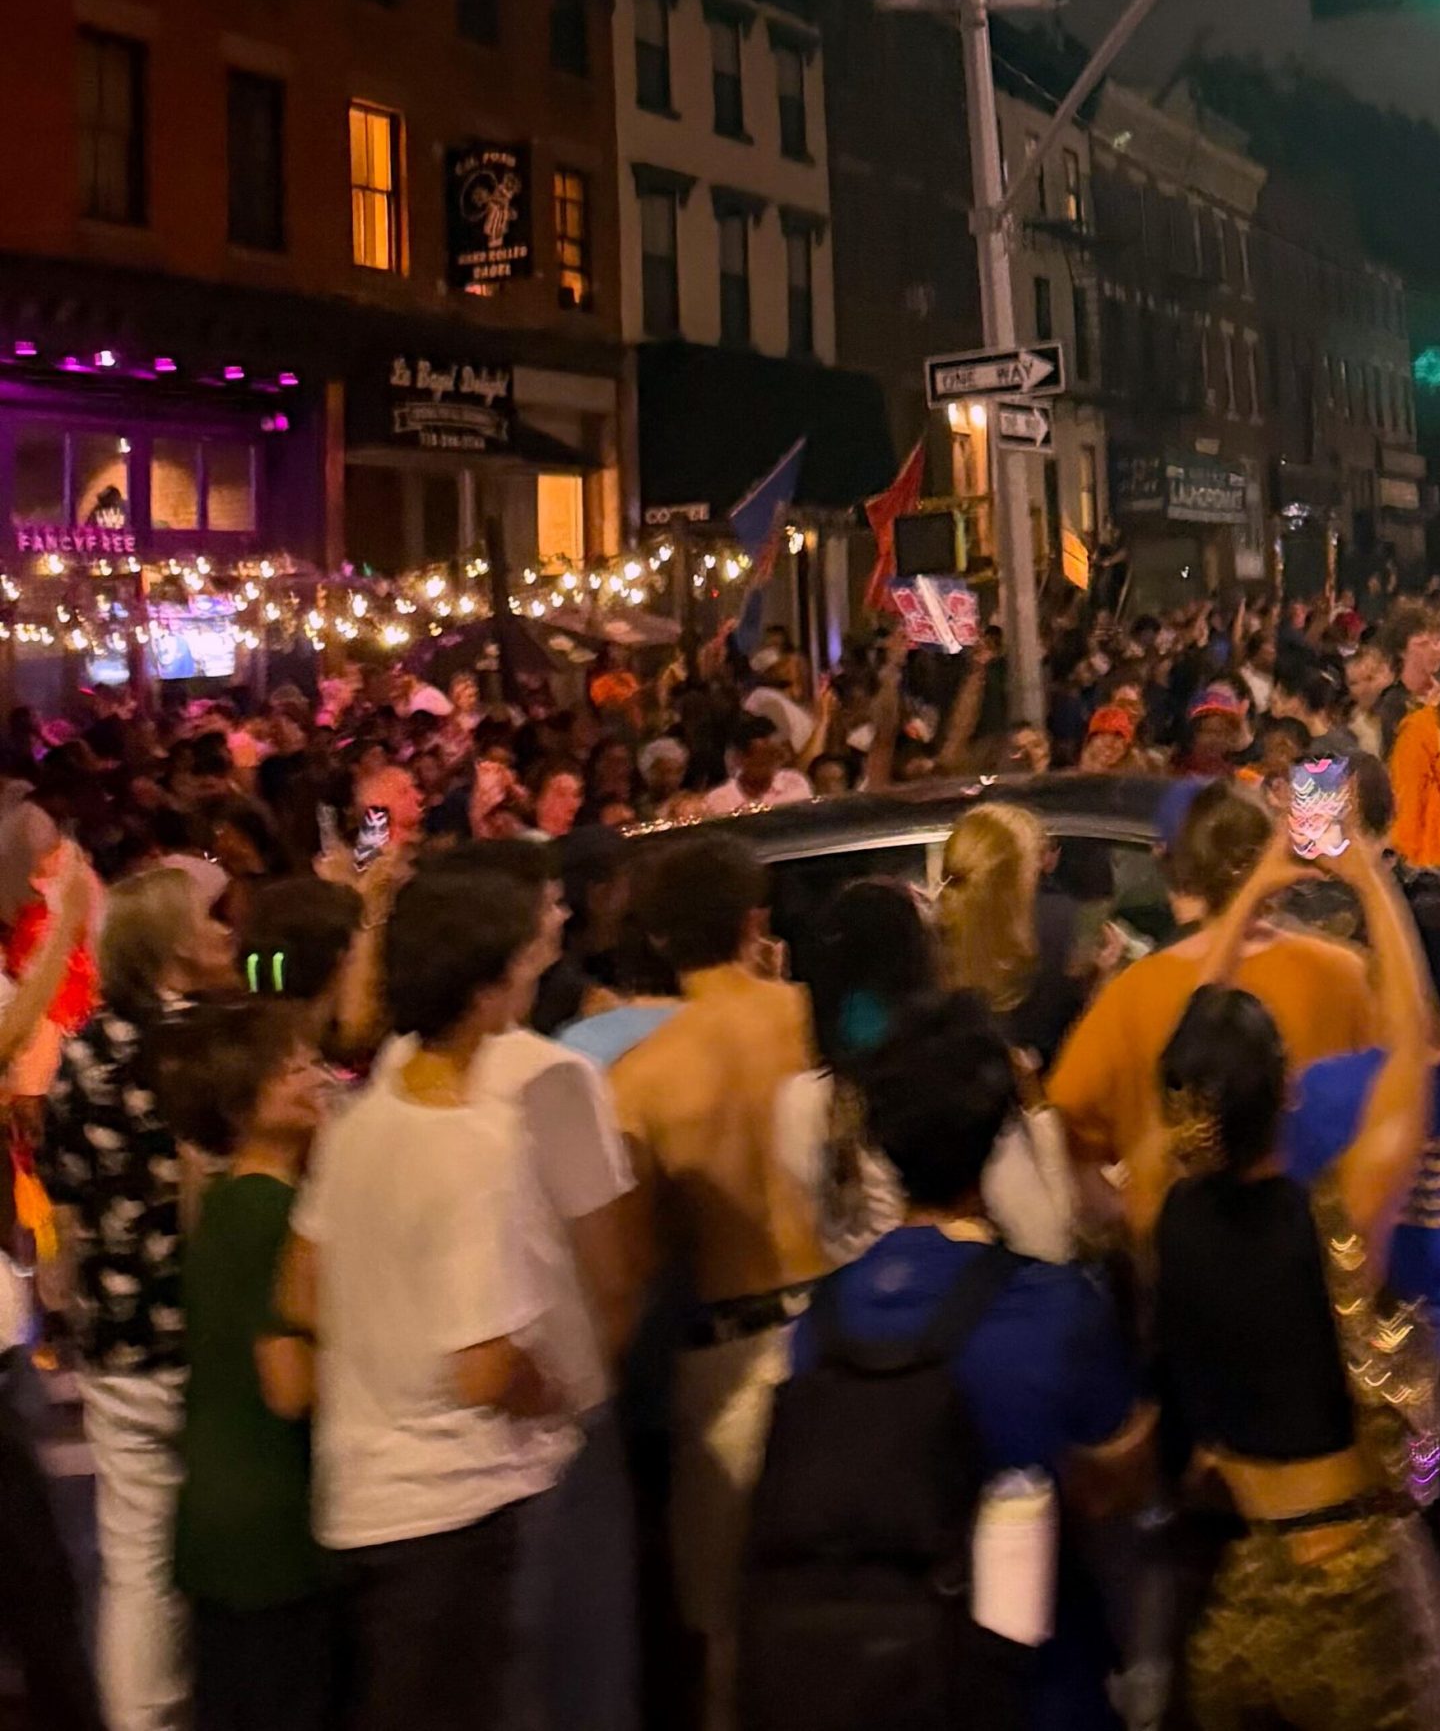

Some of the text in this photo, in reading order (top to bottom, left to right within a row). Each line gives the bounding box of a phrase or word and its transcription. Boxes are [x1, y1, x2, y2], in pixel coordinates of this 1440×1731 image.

[942, 361, 1033, 391] ONE WAY
[18, 533, 136, 551] FANCYFREE
